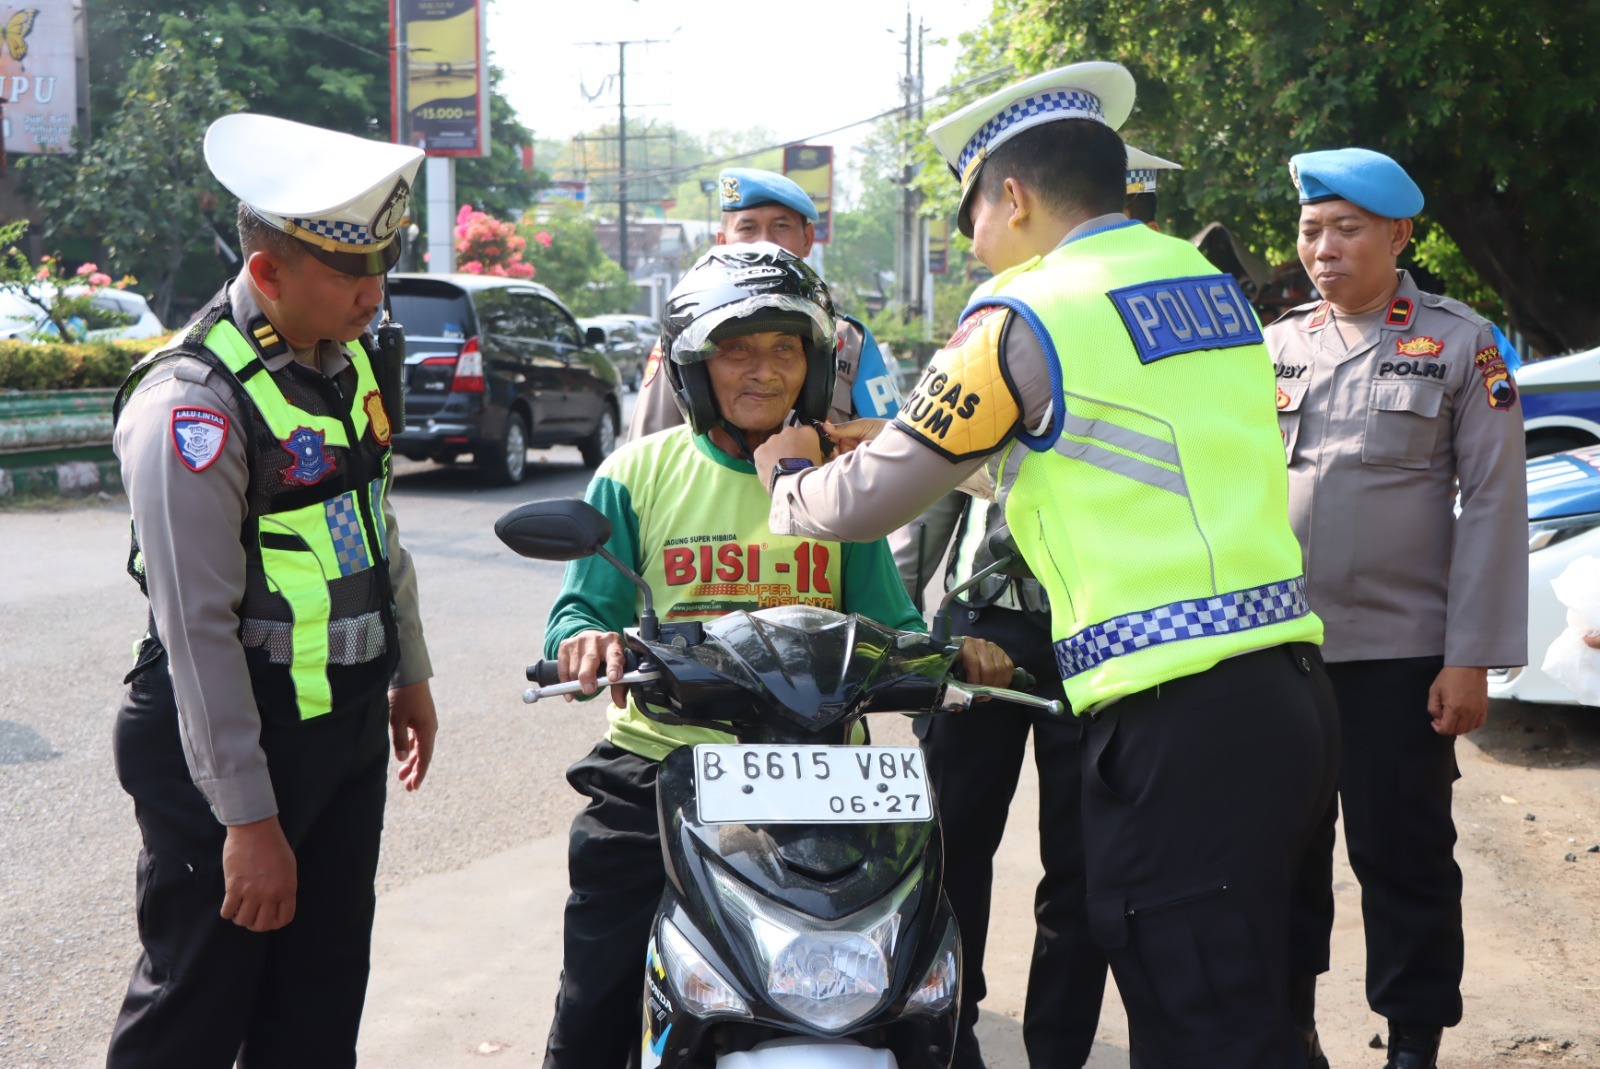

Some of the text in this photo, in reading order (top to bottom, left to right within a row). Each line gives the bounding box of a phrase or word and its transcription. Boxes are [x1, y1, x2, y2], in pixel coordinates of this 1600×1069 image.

[422, 107, 463, 120] 15.000
[1124, 283, 1254, 348] POLISI
[1273, 362, 1308, 379] UBY
[1379, 361, 1446, 380] POLRI
[920, 365, 981, 419] TGAS
[197, 411, 225, 425] LINTAS
[901, 390, 954, 440] KUM
[664, 533, 737, 547] JAGUNG SUPER HIBRIDA
[736, 583, 791, 596] SUPER
[703, 751, 728, 781] B
[743, 751, 831, 780] 6615
[647, 972, 674, 1013] HONDA
